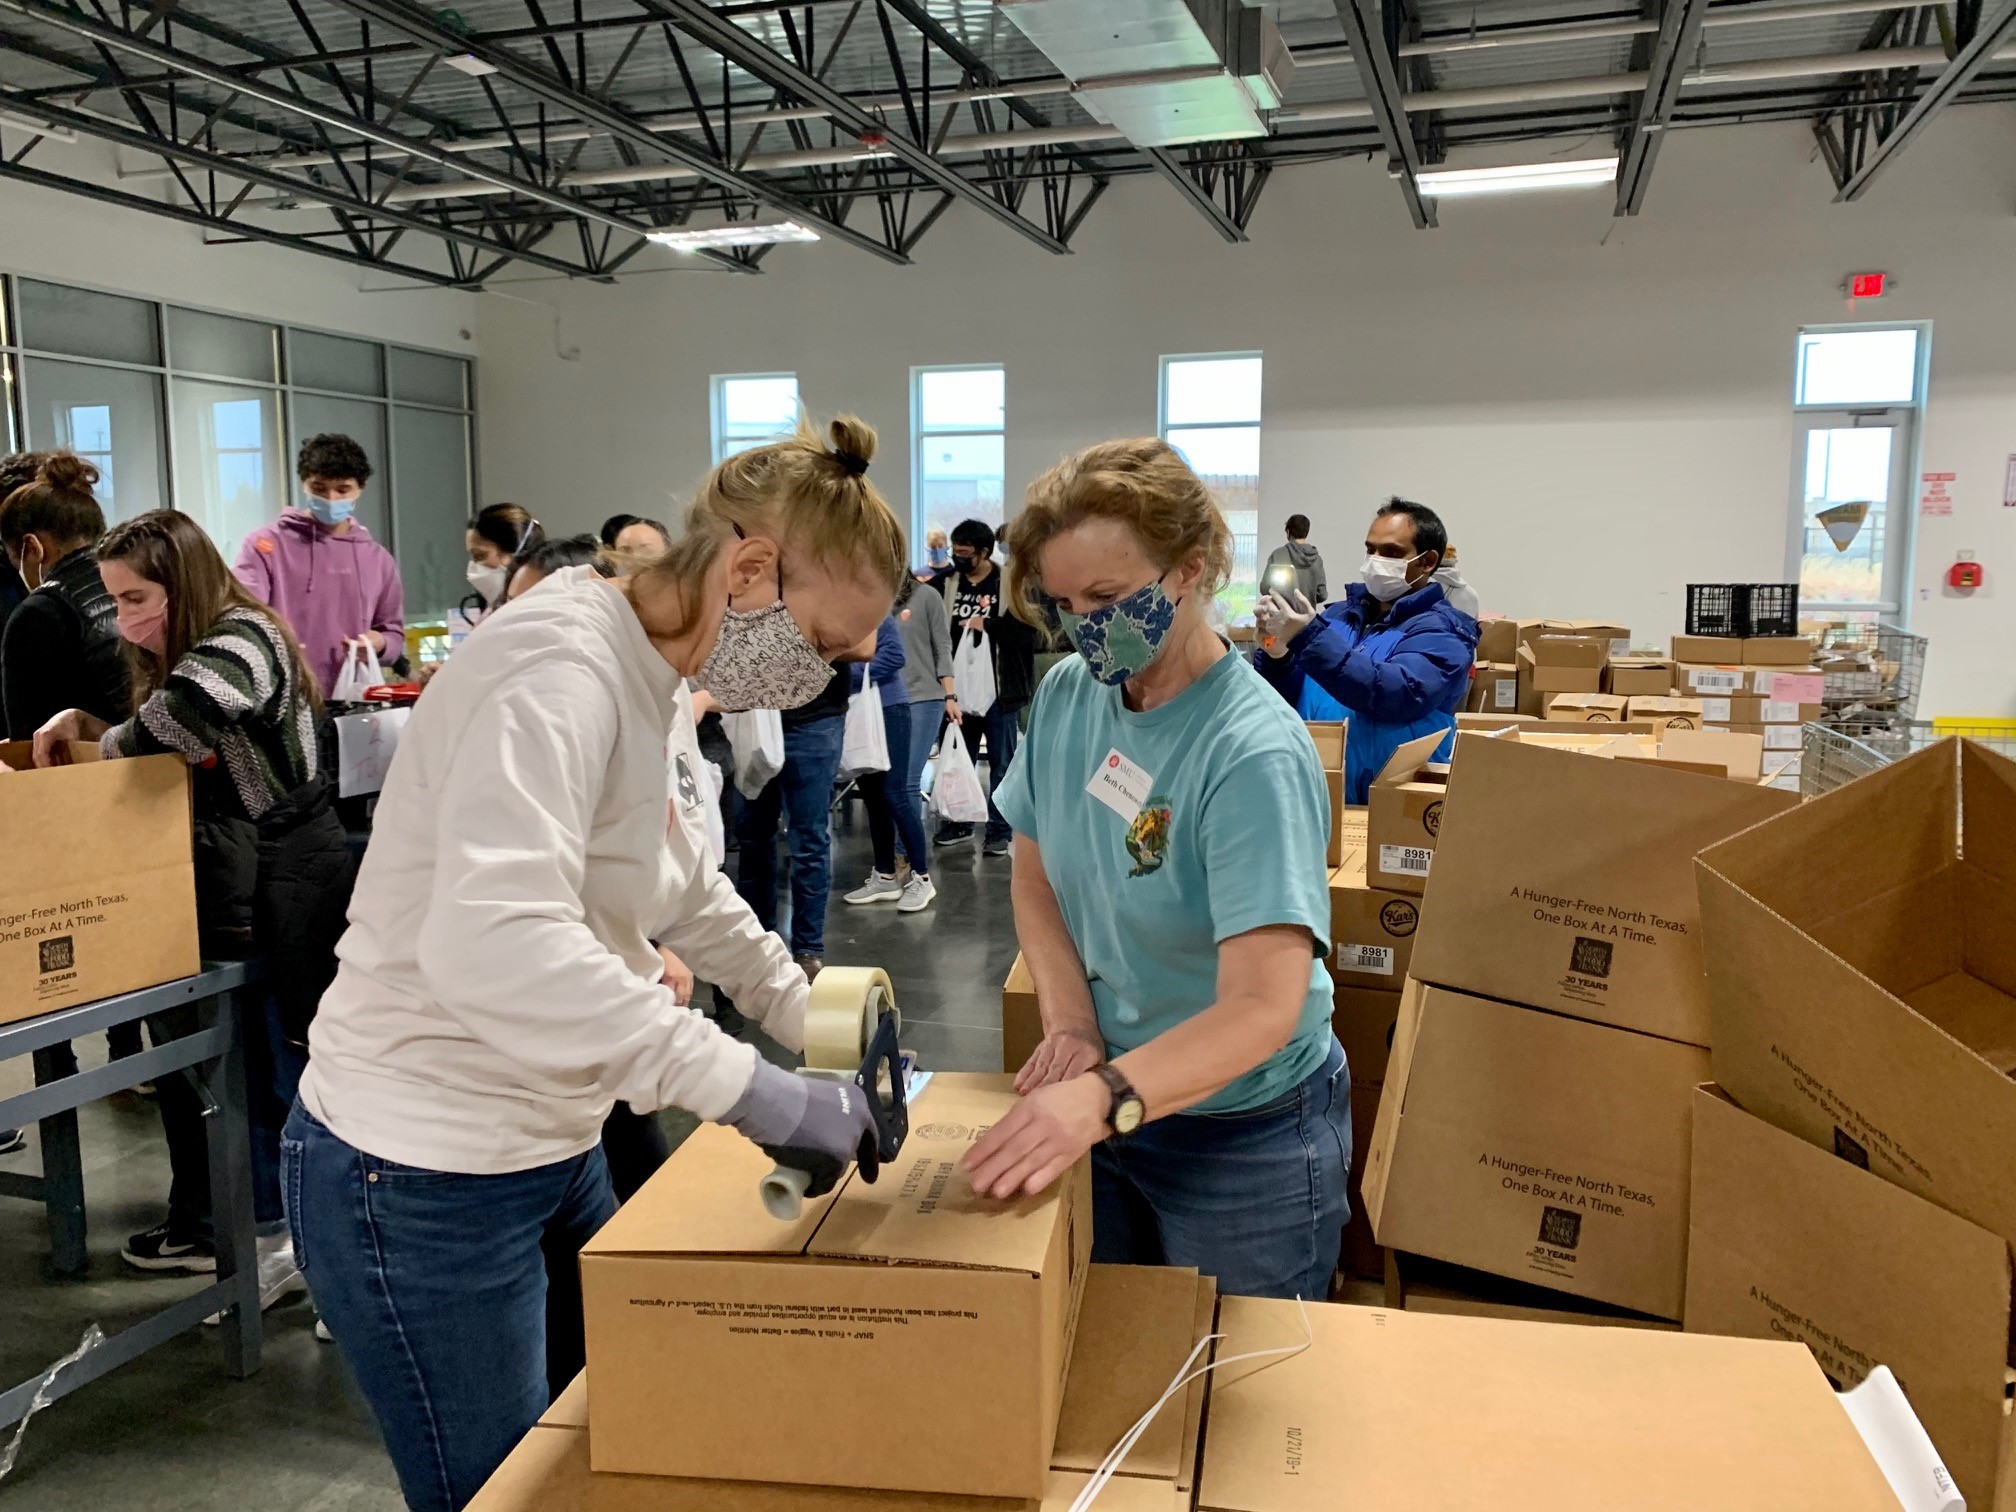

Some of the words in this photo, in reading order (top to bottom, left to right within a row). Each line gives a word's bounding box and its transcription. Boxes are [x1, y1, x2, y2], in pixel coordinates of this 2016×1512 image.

[1118, 763, 1136, 779] SMU
[1103, 774, 1118, 788] Beth
[1404, 849, 1431, 860] 8981
[60, 899, 94, 914] North
[96, 893, 129, 907] Texas,
[1385, 908, 1415, 924] Kar's
[1510, 886, 1520, 897] A
[1523, 888, 1605, 916] Hunger-Free
[1607, 906, 1646, 925] North
[1649, 914, 1688, 935] Texas,
[0, 931, 21, 944] One
[24, 925, 47, 938] Box
[50, 921, 62, 932] At
[65, 918, 74, 928] A
[76, 913, 107, 927] Time.
[1533, 908, 1561, 924] One
[1564, 915, 1587, 931] Box
[1590, 922, 1606, 934] At
[1608, 926, 1618, 937] A
[1622, 926, 1657, 945] Time.
[1361, 946, 1388, 958] 8981
[38, 978, 49, 986] 30
[49, 971, 77, 985] YEARS
[1565, 975, 1576, 984] 30
[1578, 977, 1608, 991] YEARS
[1771, 1045, 1779, 1057] A
[1781, 1052, 1853, 1116] Hunger-Free
[1855, 1111, 1892, 1148] North
[1794, 1077, 1817, 1103] One
[1821, 1099, 1841, 1122] Box
[1844, 1120, 1858, 1135] At
[1861, 1134, 1870, 1145] A
[1479, 1153, 1488, 1165] A
[1491, 1156, 1573, 1185] Hunger-Free
[1576, 1175, 1614, 1195] North
[1617, 1185, 1656, 1207] Texas,
[1502, 1177, 1529, 1193] One
[1533, 1184, 1556, 1200] Box
[1559, 1192, 1575, 1204] At
[1577, 1196, 1587, 1207] A
[1590, 1197, 1625, 1217] Time.
[1534, 1246, 1545, 1255] 30
[1546, 1248, 1577, 1262] YEARS
[747, 1303, 763, 1311] from
[763, 1303, 784, 1311] funds
[784, 1305, 809, 1313] federal
[810, 1306, 826, 1314] with
[827, 1305, 841, 1314] part
[851, 1307, 868, 1315] least
[878, 1308, 903, 1316] funded
[905, 1309, 922, 1317] been
[742, 1310, 770, 1319] provider
[818, 1313, 837, 1322] equal
[937, 1309, 962, 1318] project
[894, 1317, 908, 1325] This
[729, 1326, 759, 1335] Nutrition
[761, 1328, 782, 1336] Better
[790, 1328, 816, 1337] Veggies
[1750, 1286, 1758, 1300] A
[1760, 1291, 1830, 1345] Hunger-Free
[1833, 1336, 1870, 1369] North
[1770, 1318, 1794, 1341] One
[1821, 1351, 1833, 1368] At
[1837, 1361, 1845, 1376] A
